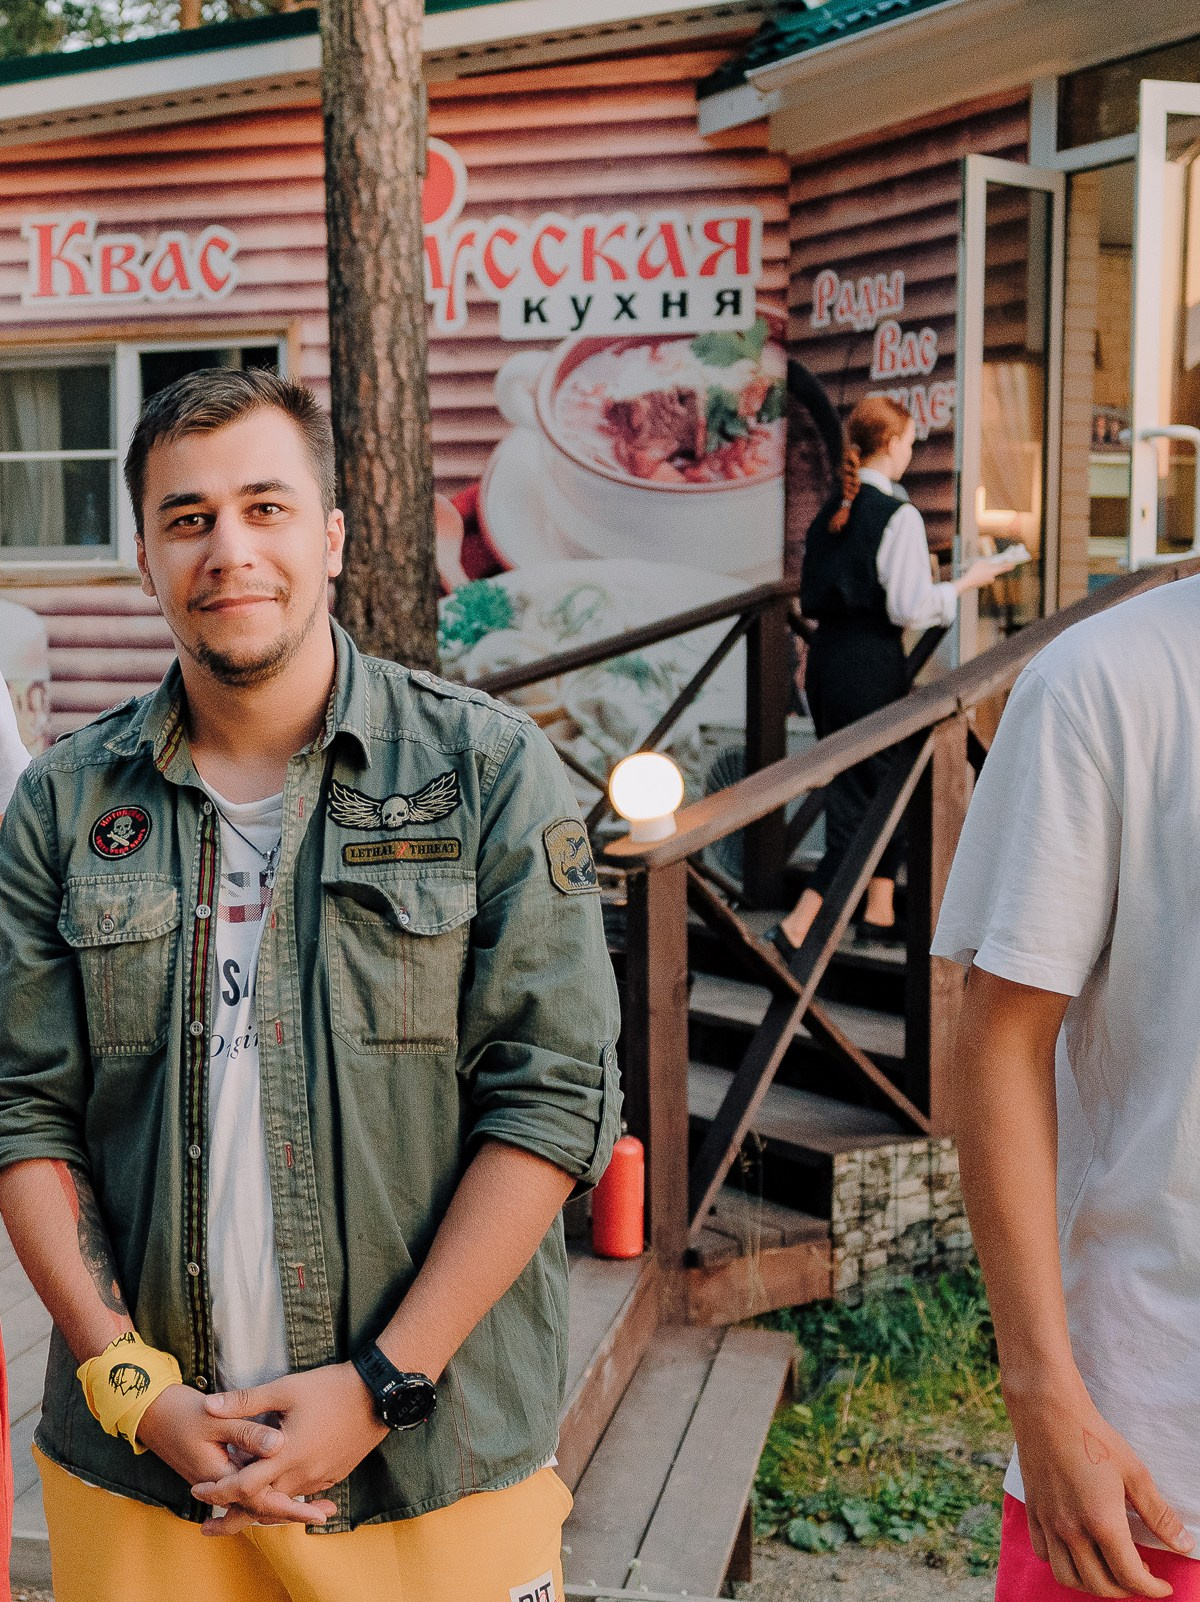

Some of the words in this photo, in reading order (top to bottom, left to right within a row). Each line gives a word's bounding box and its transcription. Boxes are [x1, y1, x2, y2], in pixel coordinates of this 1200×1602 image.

[523, 288, 743, 332] кухня
[350, 845, 395, 858] LETHAL
[409, 843, 457, 855] THREAT
